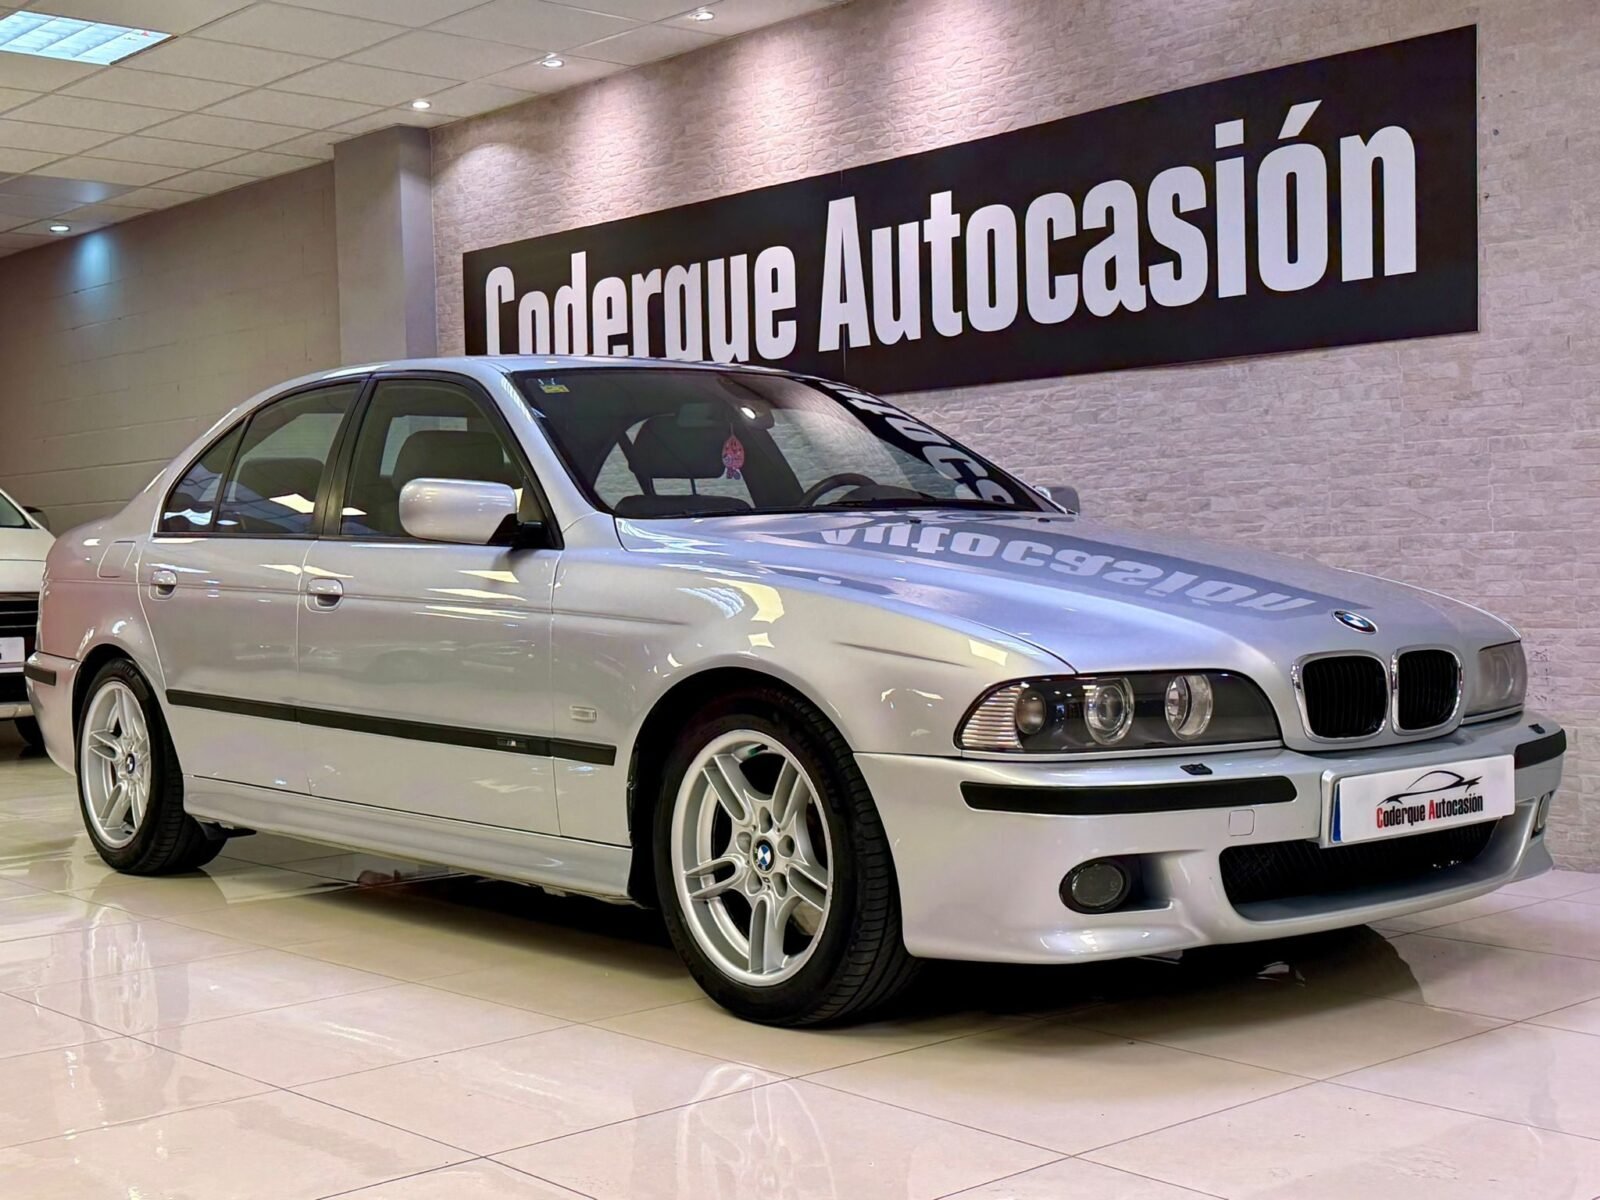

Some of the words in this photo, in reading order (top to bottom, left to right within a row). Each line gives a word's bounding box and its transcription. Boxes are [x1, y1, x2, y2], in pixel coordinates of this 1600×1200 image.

[485, 246, 797, 363] Coderque
[818, 99, 1417, 352] Autocasión
[1376, 804, 1426, 829] Coderque
[1428, 793, 1484, 820] Autocasión
